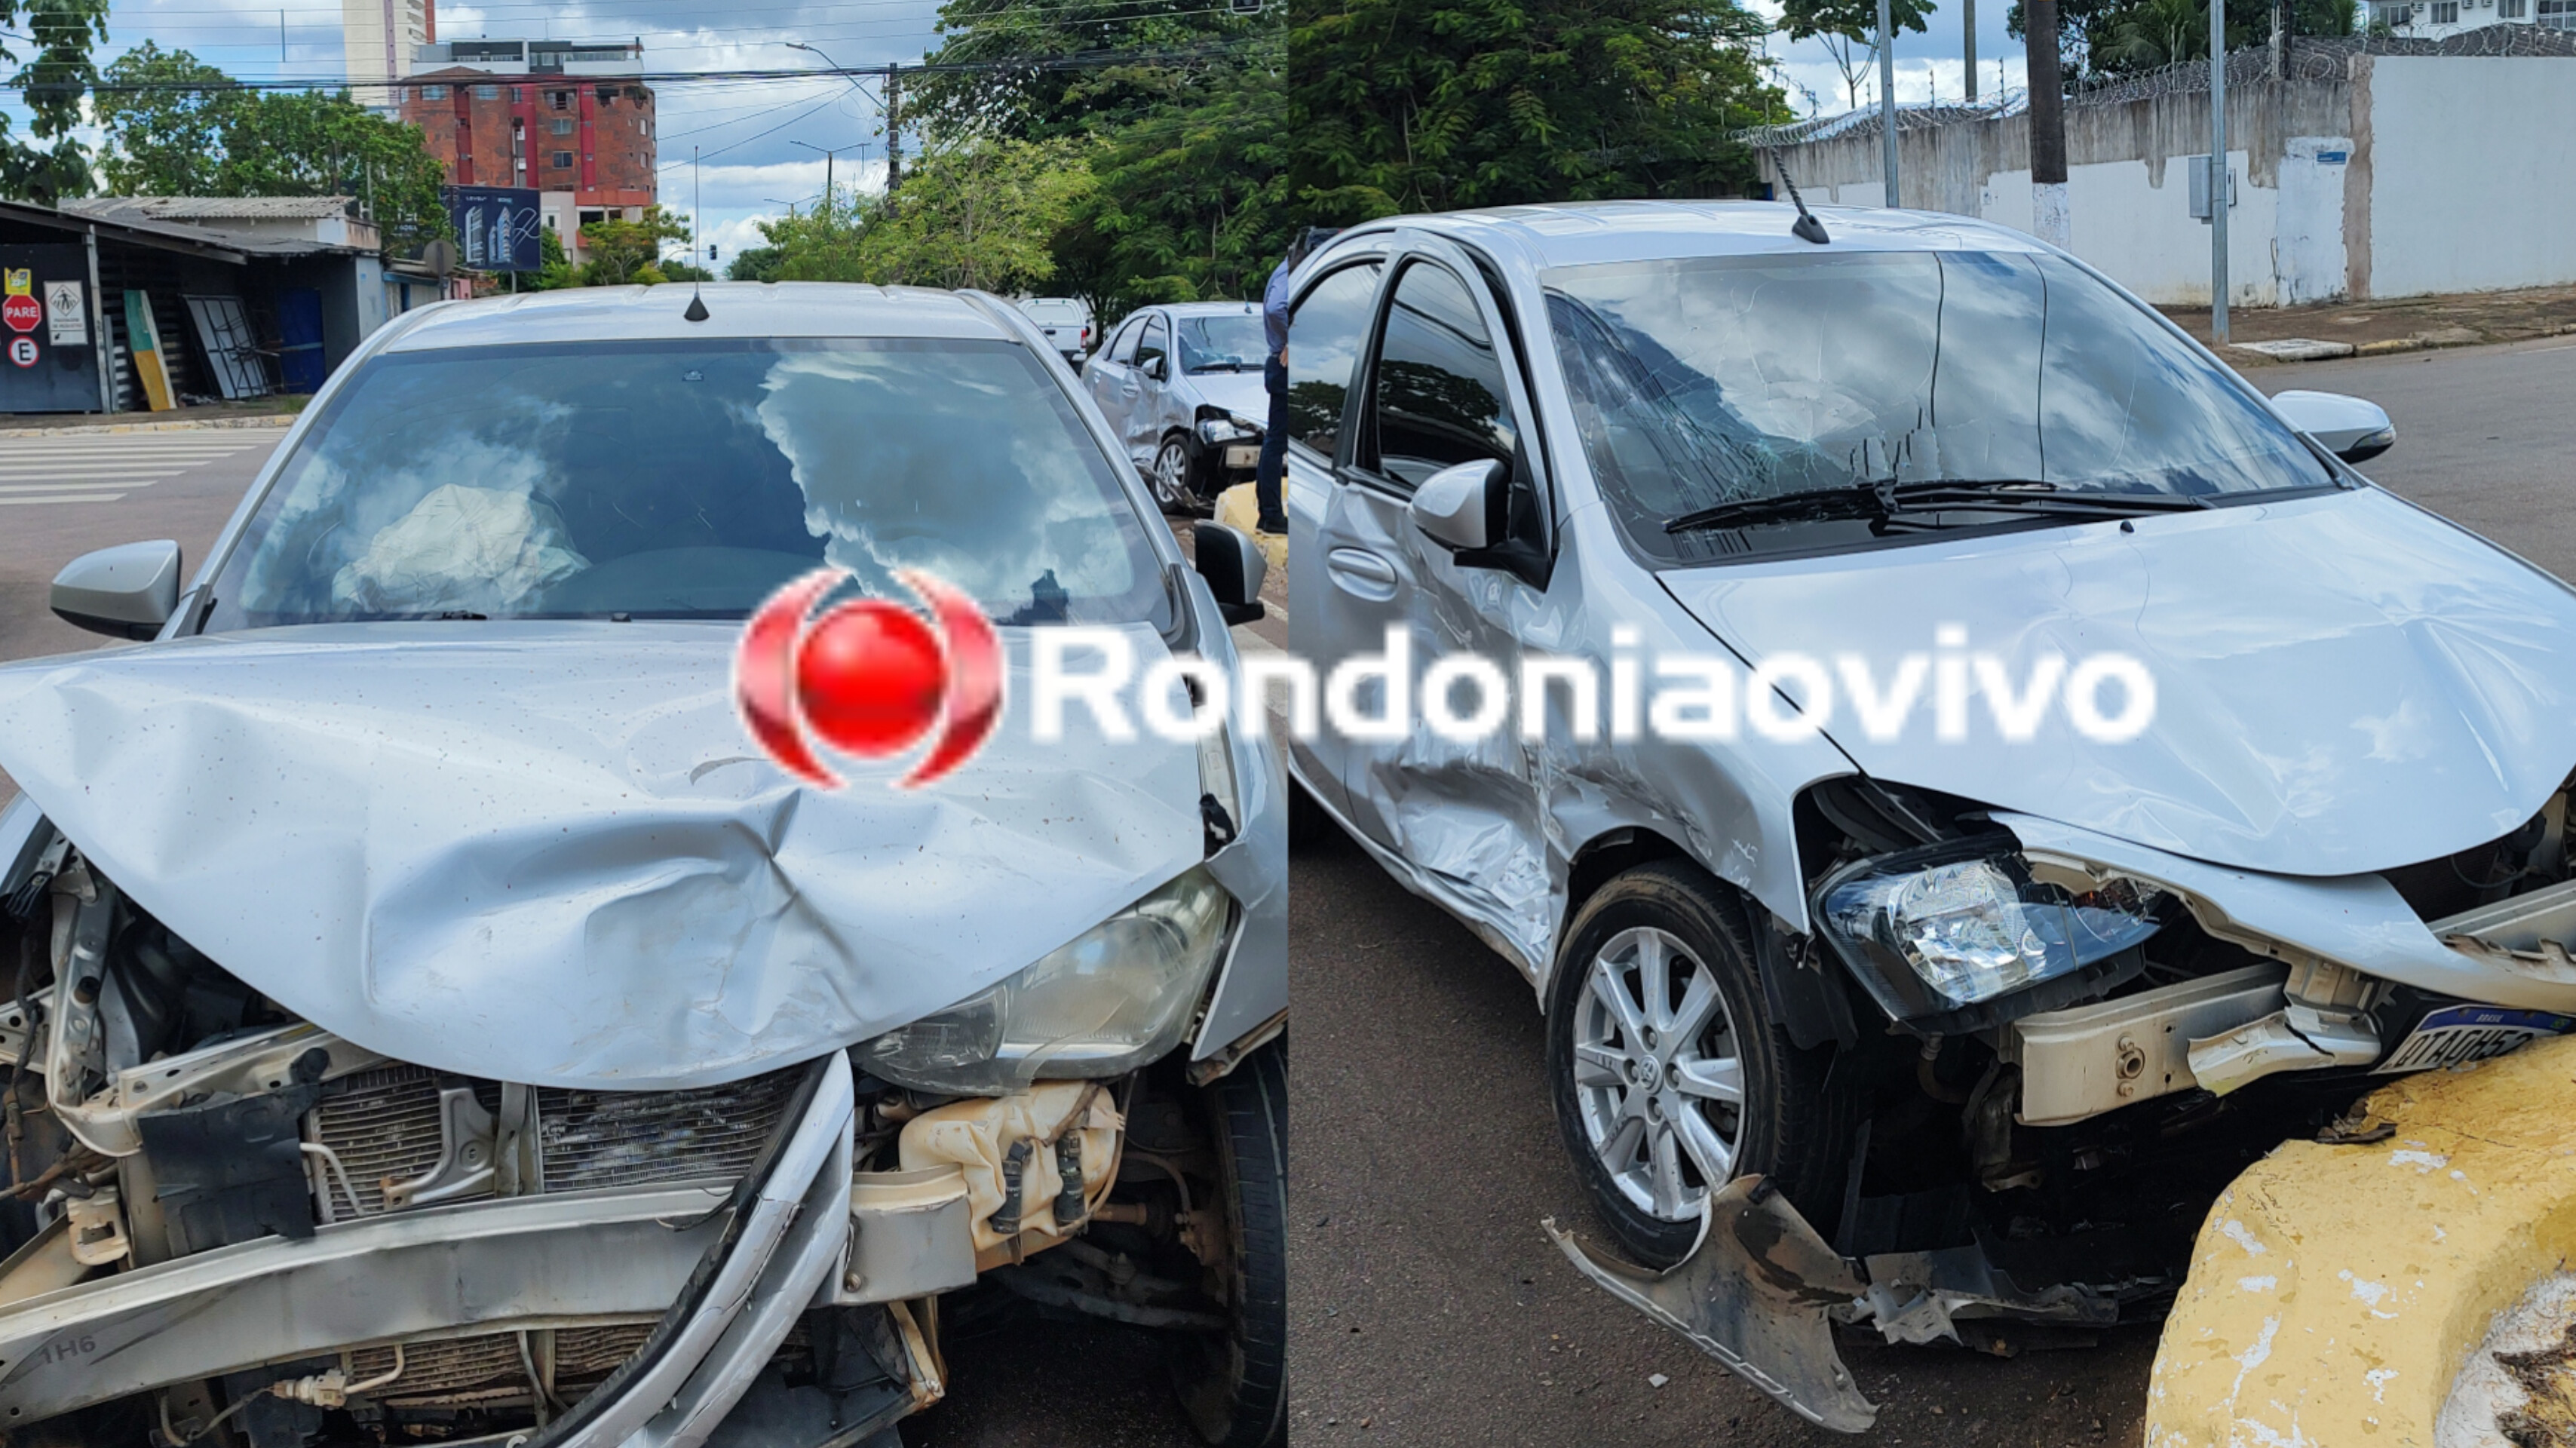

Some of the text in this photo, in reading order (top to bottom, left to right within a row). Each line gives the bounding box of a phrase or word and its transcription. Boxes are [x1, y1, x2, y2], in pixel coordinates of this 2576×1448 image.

[6, 307, 38, 318] PARE
[18, 342, 31, 360] E
[2476, 1014, 2504, 1022] BRASIL
[39, 1335, 96, 1364] 1H6
